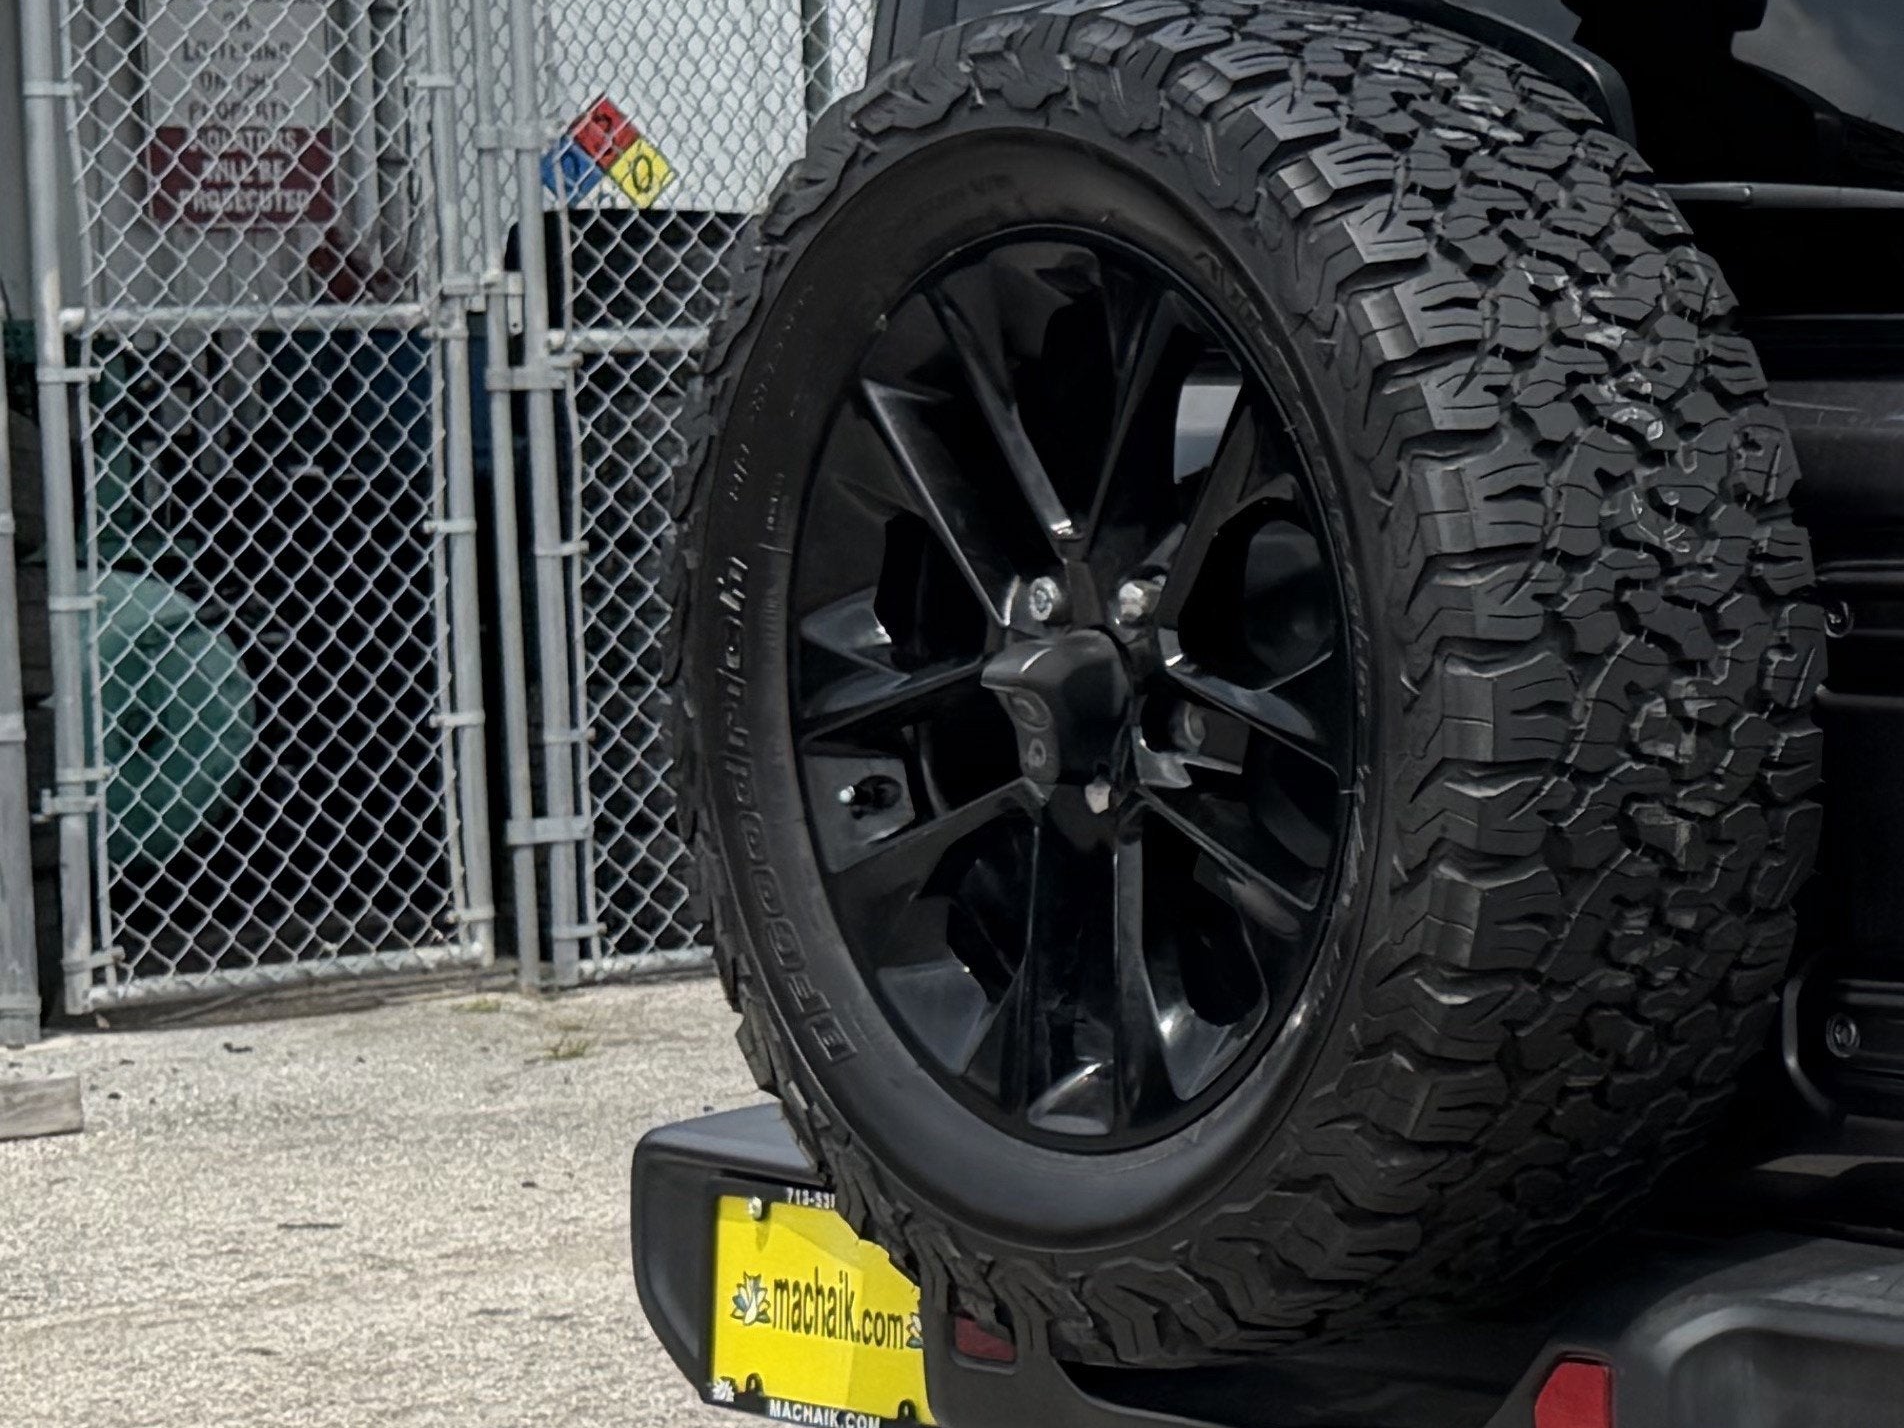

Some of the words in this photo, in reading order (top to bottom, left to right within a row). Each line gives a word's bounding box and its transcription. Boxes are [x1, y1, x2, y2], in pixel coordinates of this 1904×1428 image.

[190, 127, 298, 153] IOLATORS
[631, 154, 653, 193] 0
[772, 1266, 904, 1350] machaik.com
